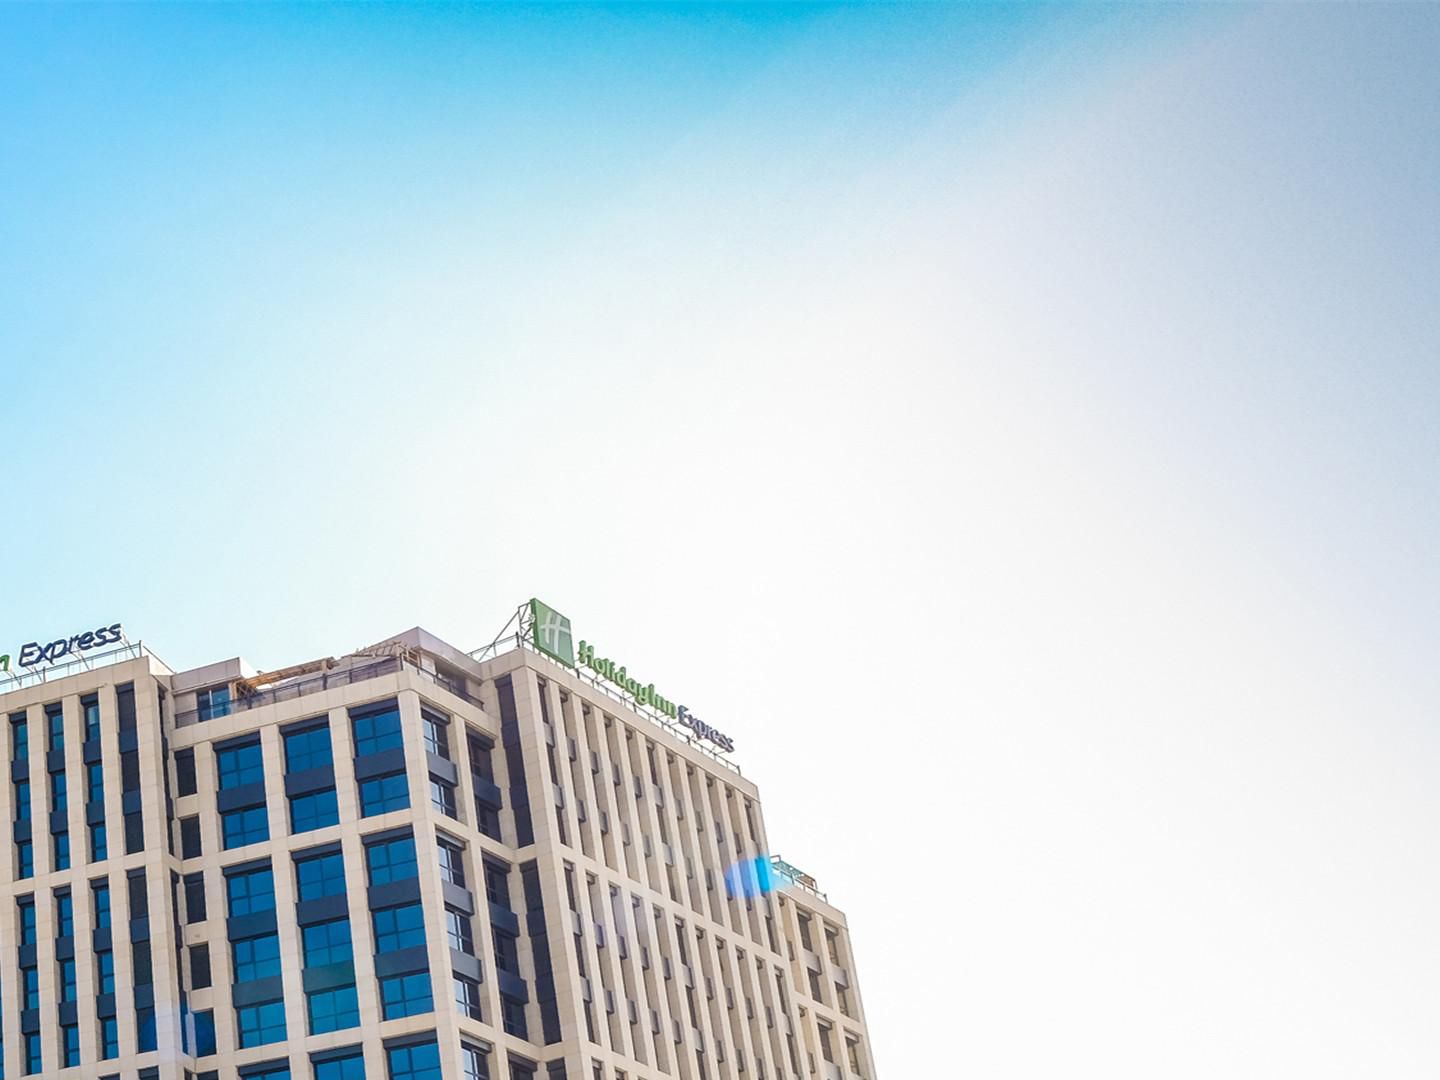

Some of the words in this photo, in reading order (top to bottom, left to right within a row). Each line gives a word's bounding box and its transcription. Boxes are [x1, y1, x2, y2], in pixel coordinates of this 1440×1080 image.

[18, 622, 123, 668] Express
[578, 640, 648, 706] Holiday
[648, 683, 676, 719] Inn
[677, 704, 735, 753] Express
